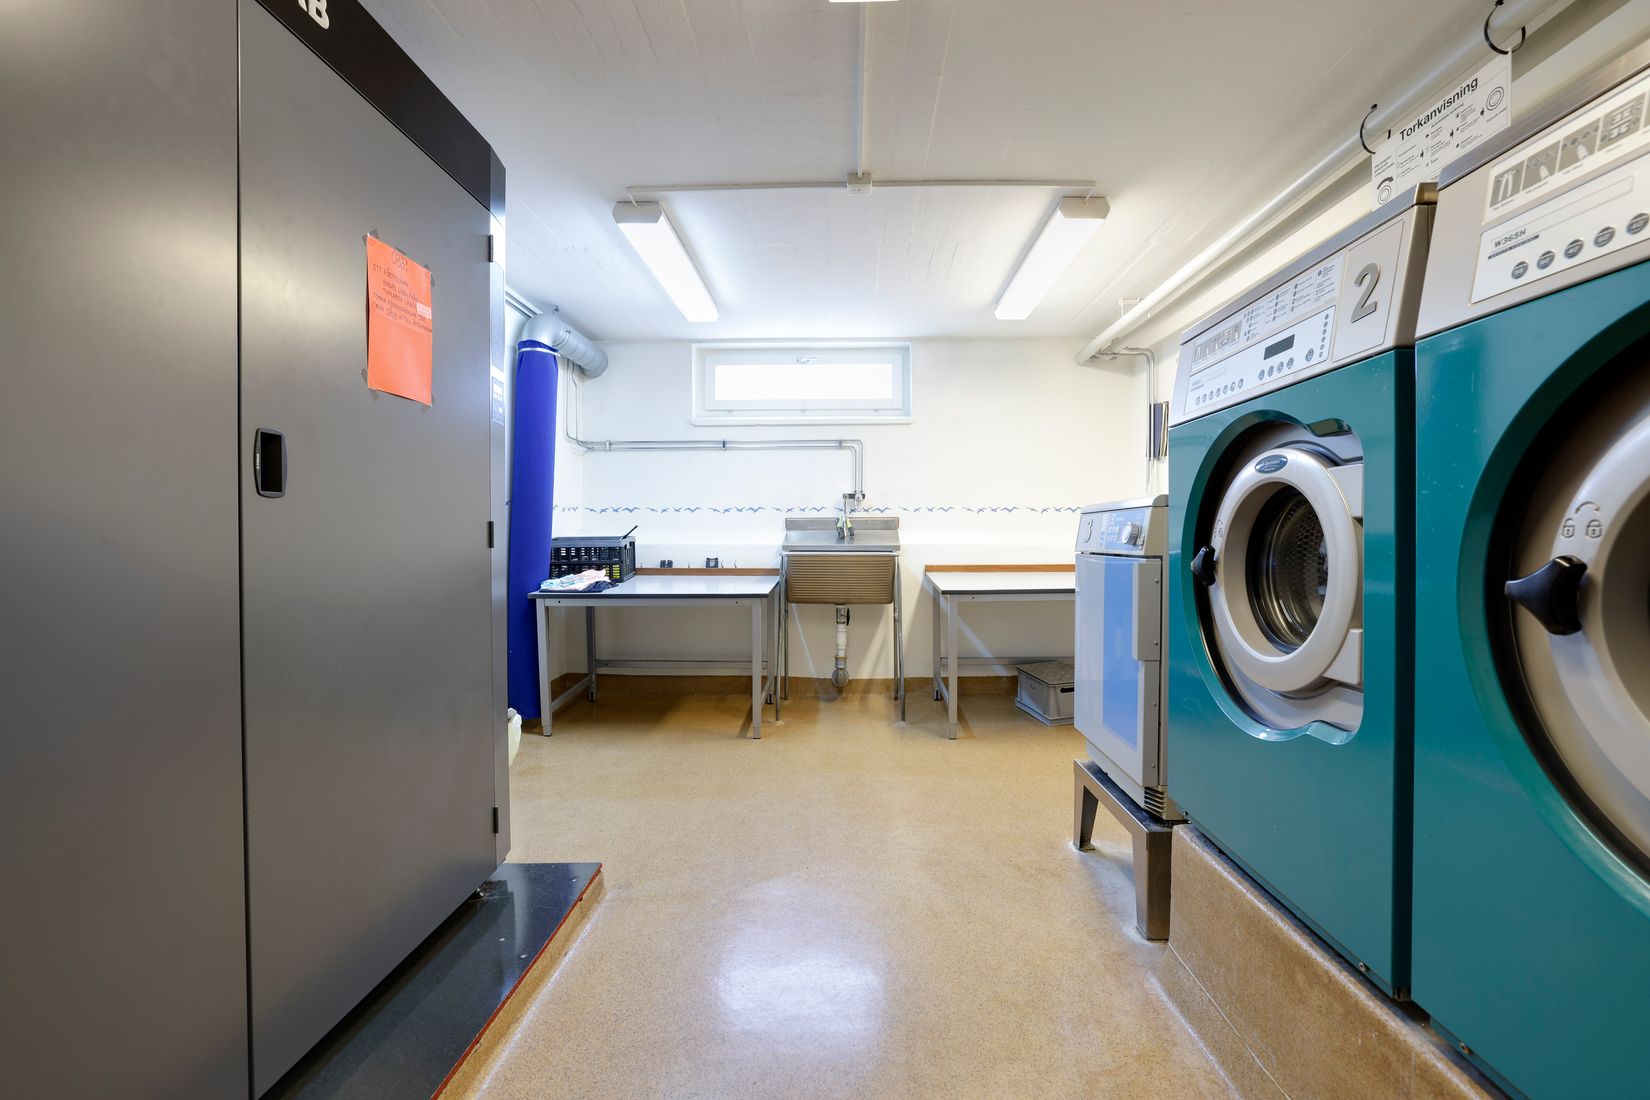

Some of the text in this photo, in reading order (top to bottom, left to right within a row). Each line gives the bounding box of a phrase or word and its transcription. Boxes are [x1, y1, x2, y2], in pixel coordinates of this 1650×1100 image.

[298, 0, 330, 30] B
[1399, 77, 1478, 141] Torkanvisning
[1493, 227, 1527, 249] W365H
[391, 250, 408, 272] OBS!
[1350, 262, 1382, 324] 2
[1083, 519, 1094, 544] 3
